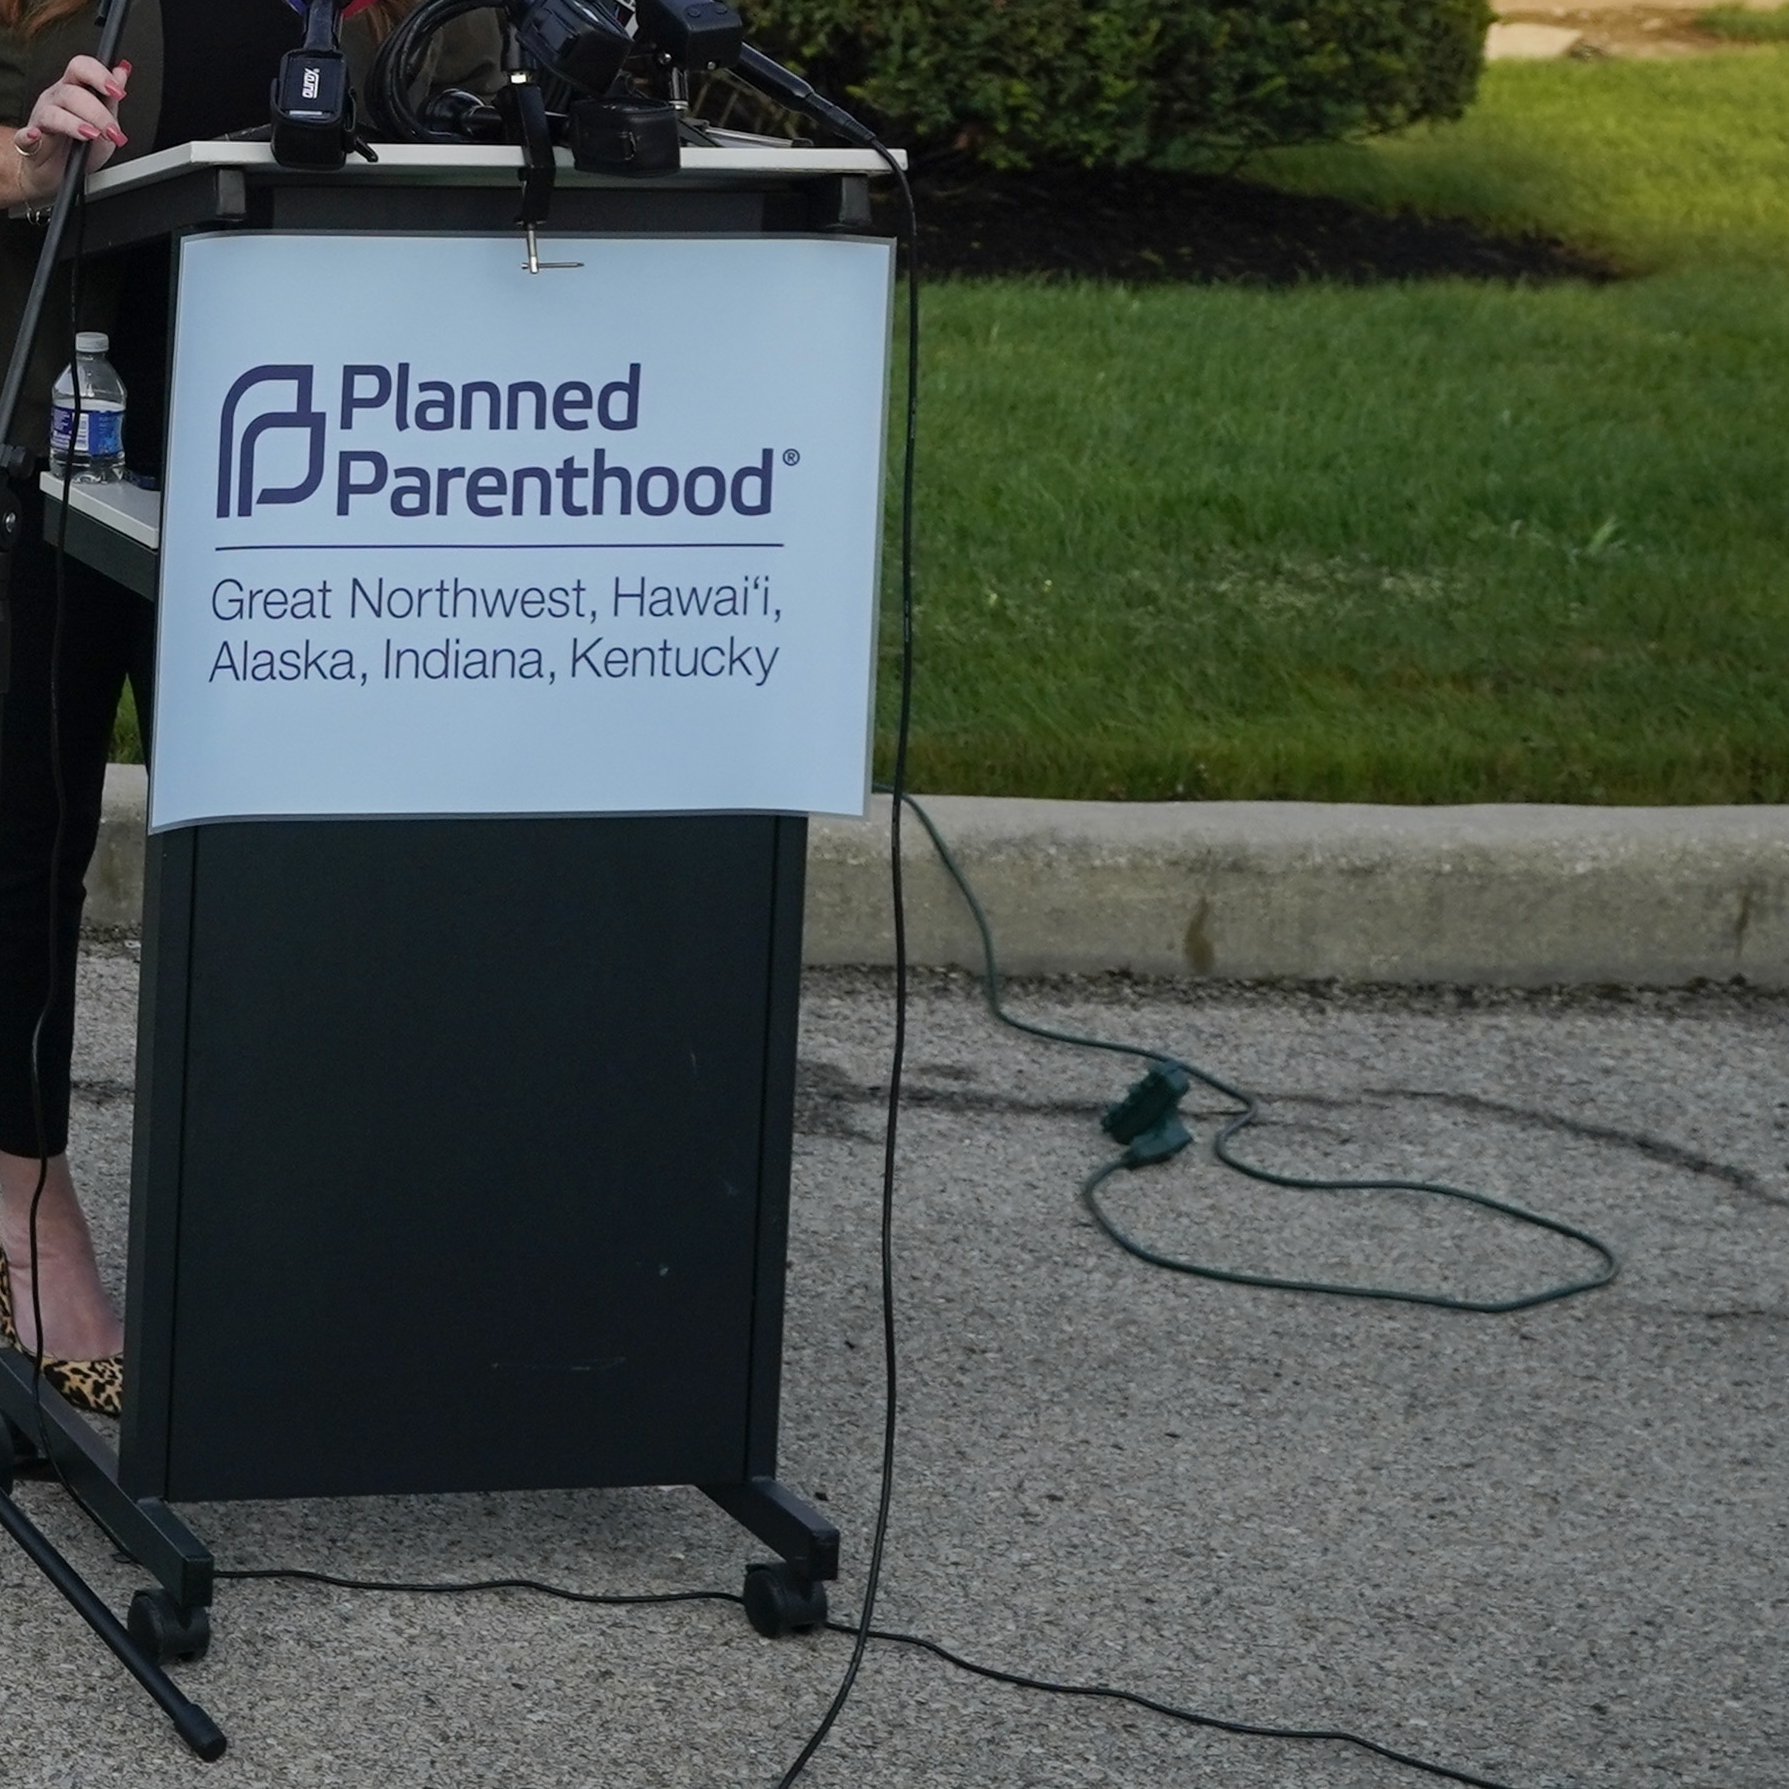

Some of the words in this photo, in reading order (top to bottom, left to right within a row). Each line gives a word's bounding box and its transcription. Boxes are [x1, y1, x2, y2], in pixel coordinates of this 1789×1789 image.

[339, 362, 641, 432] Planned
[211, 577, 333, 621] Great
[350, 576, 598, 624] Northwest,
[209, 639, 368, 686] Alaska,
[383, 637, 557, 685] Indiana,
[570, 635, 781, 686] Kentucky
